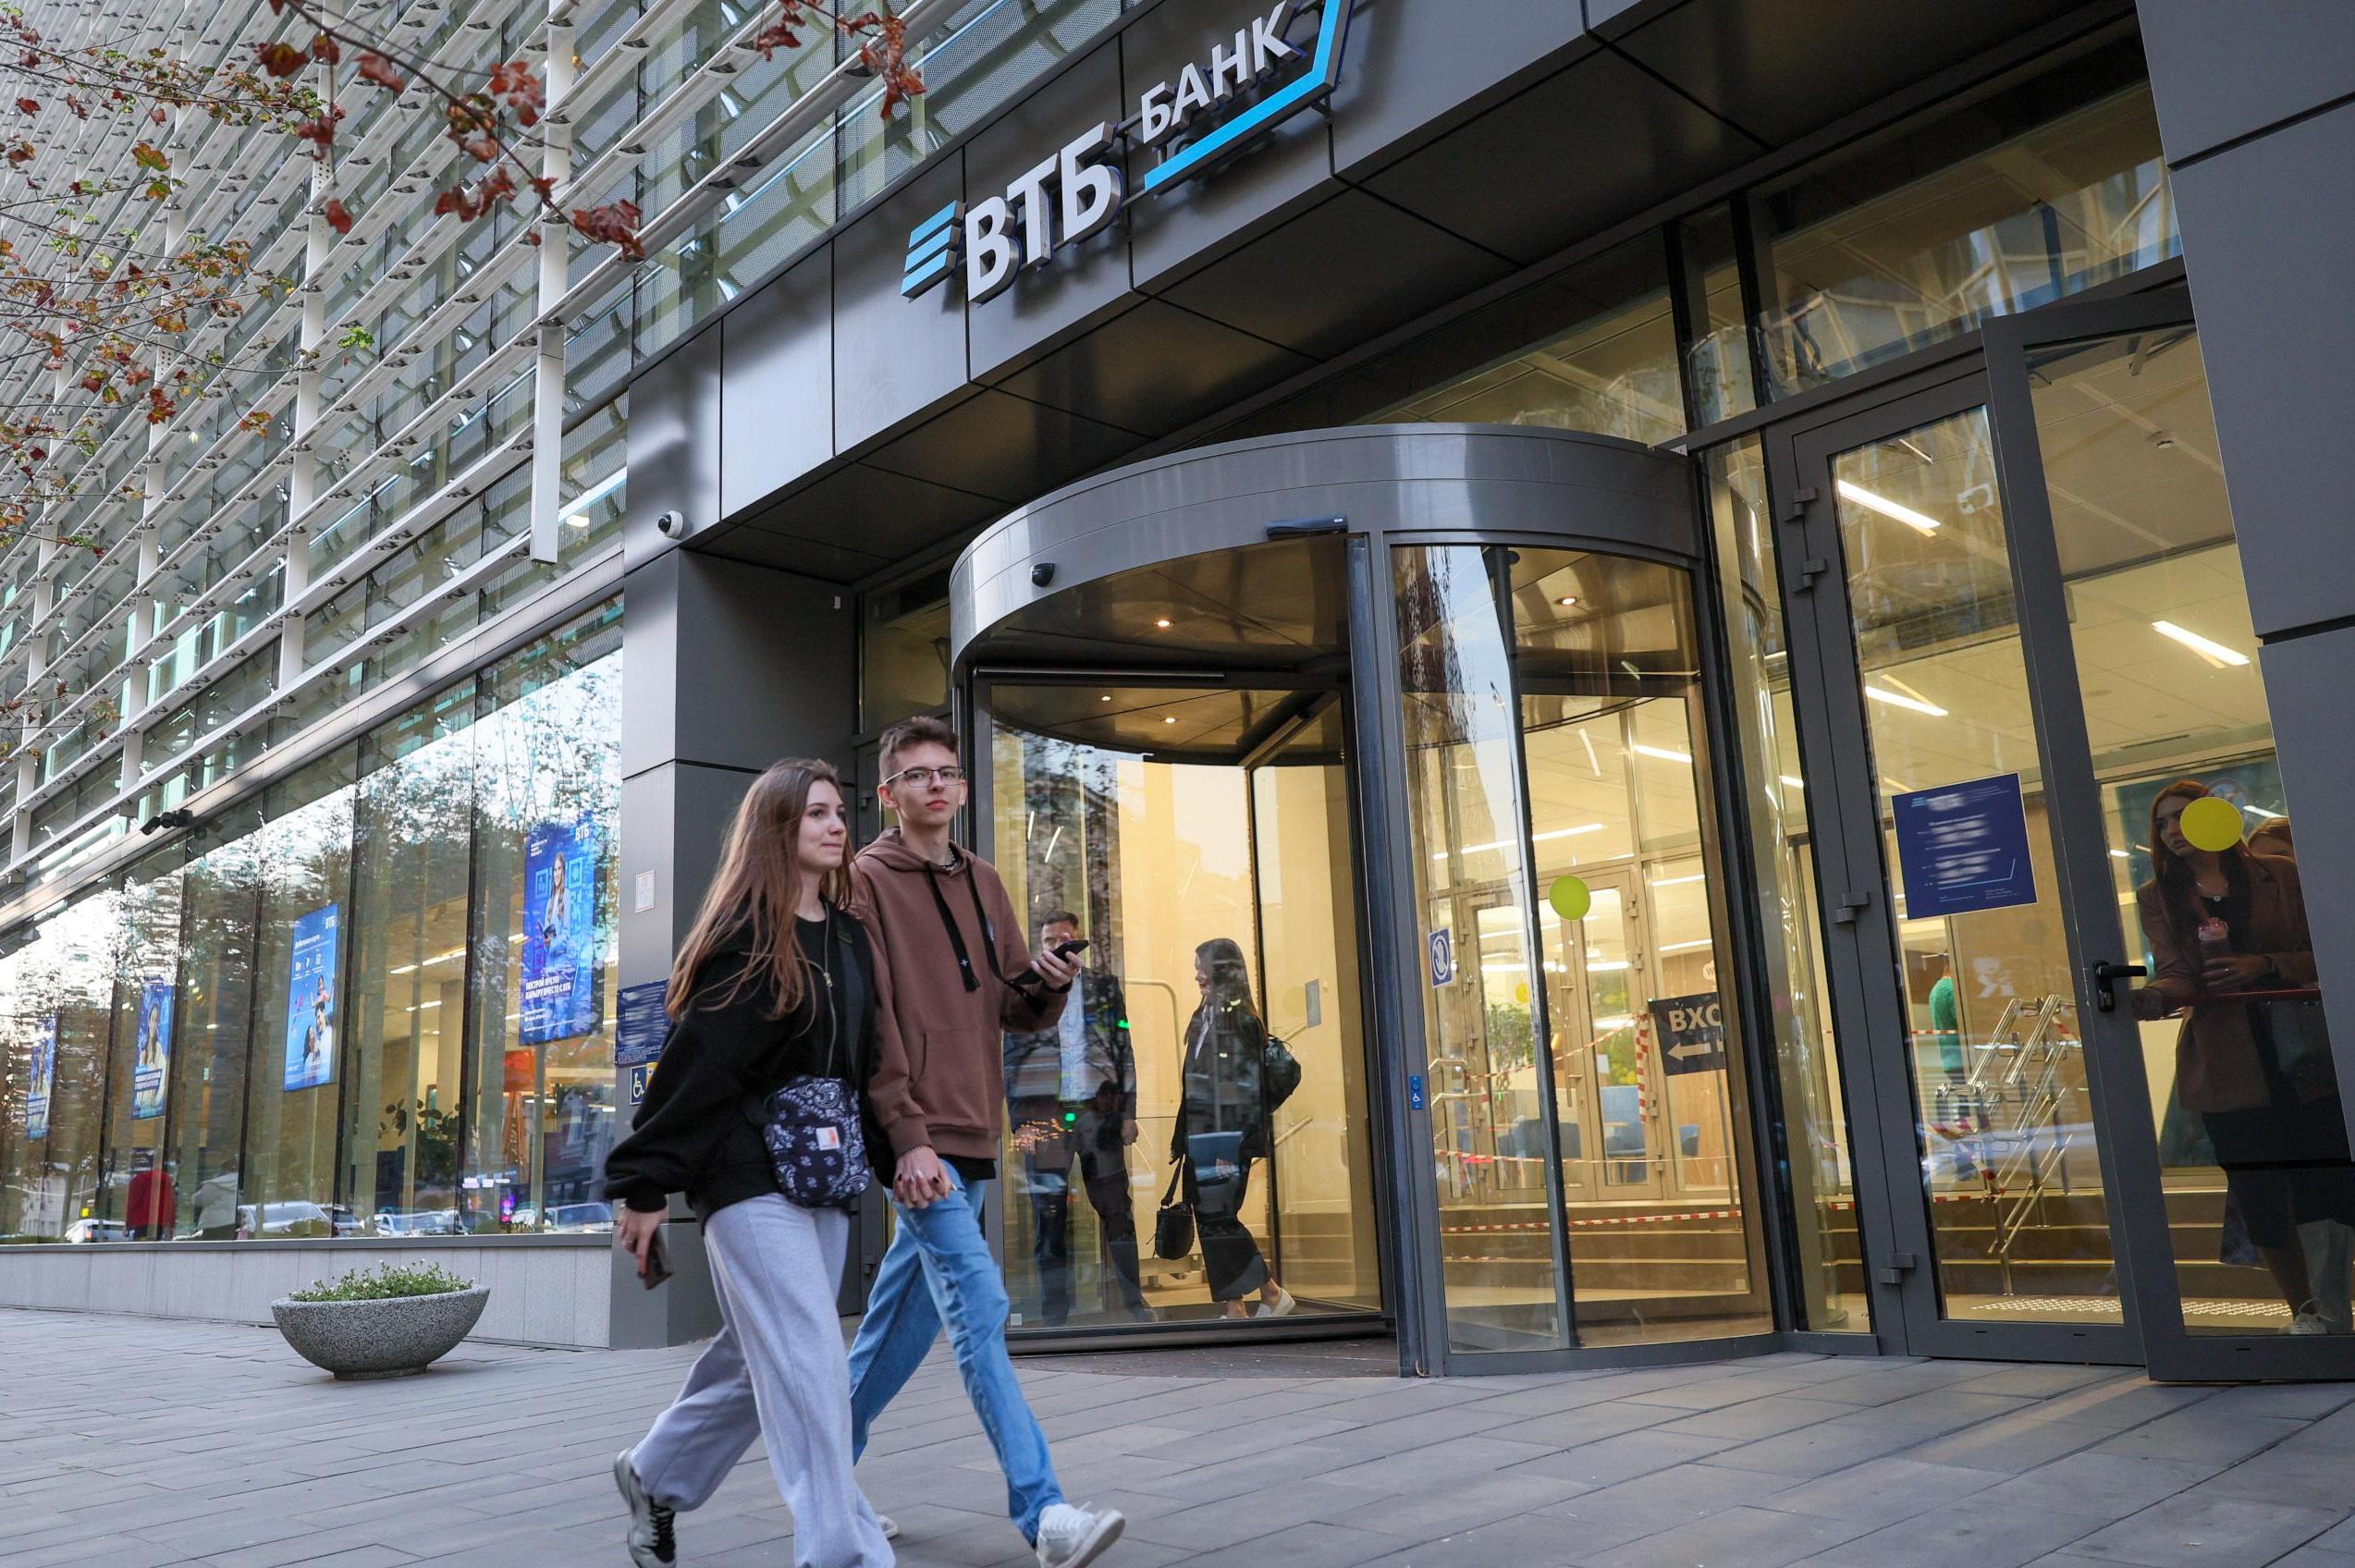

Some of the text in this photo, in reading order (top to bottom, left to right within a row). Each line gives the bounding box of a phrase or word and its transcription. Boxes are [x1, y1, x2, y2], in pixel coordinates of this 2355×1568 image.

[965, 0, 1296, 304] ВТБ БАНК
[575, 823, 590, 841] ВТБ
[325, 915, 336, 929] ВТБ
[1668, 1003, 1722, 1033] ВХО
